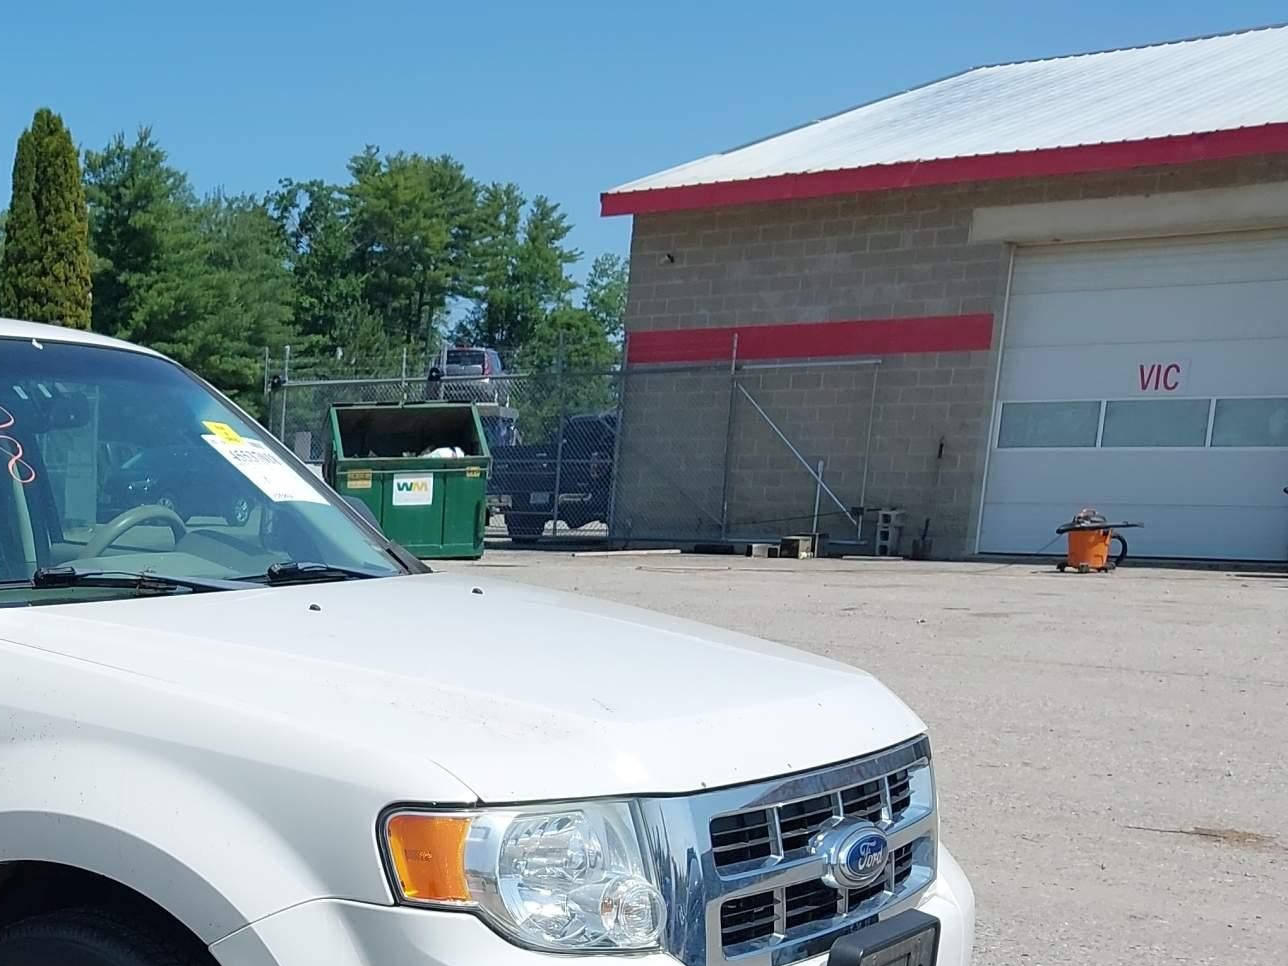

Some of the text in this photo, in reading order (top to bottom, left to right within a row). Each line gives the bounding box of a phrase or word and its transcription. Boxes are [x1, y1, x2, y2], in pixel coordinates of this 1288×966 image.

[1139, 364, 1181, 391] VIC
[396, 481, 429, 493] WM
[858, 840, 884, 871] Ford
